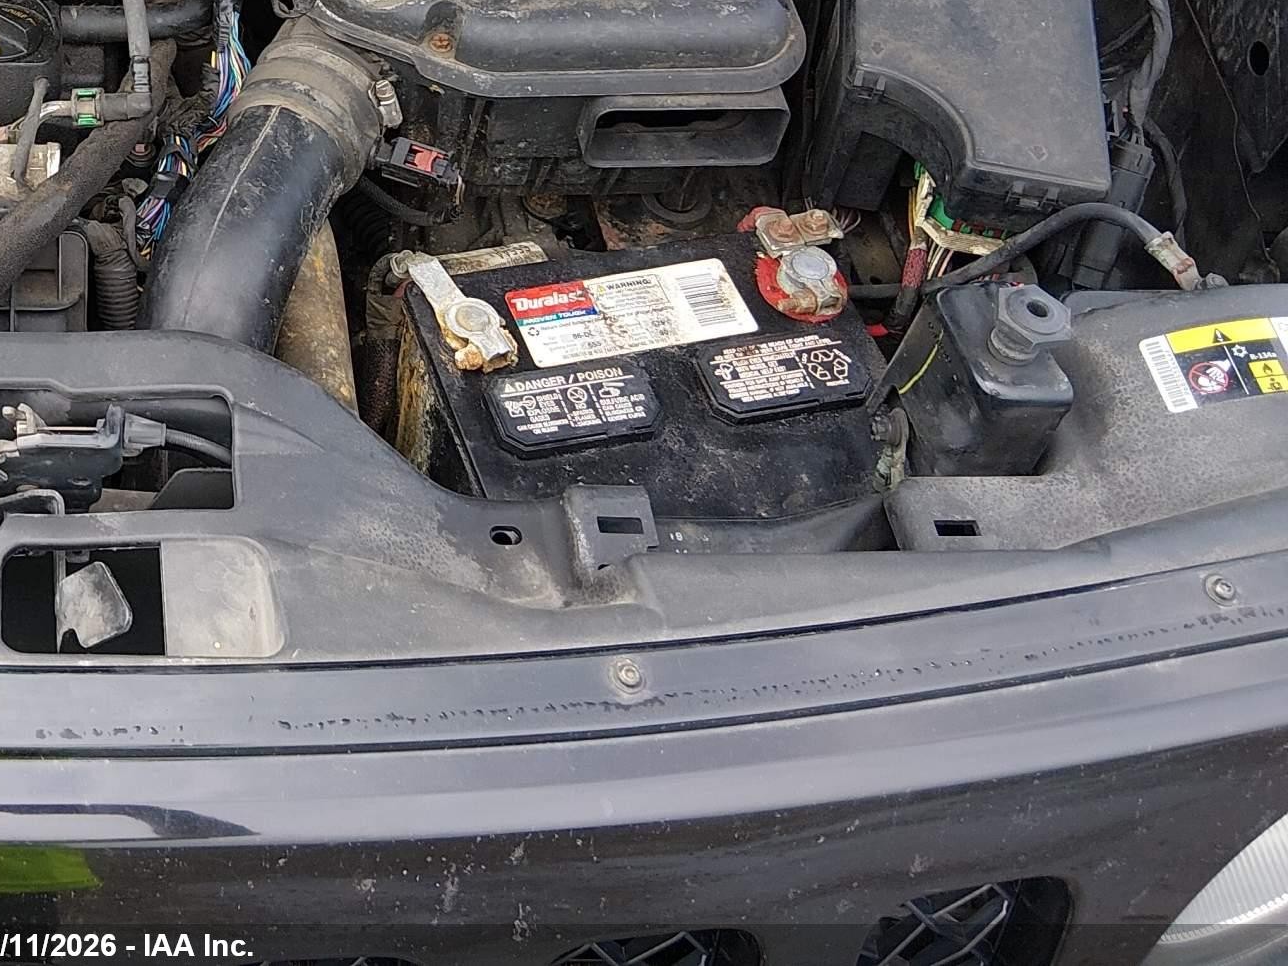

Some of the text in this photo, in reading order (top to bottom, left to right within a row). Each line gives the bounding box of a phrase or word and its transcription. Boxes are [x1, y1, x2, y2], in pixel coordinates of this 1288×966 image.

[515, 367, 623, 392] DANGER / POISON
